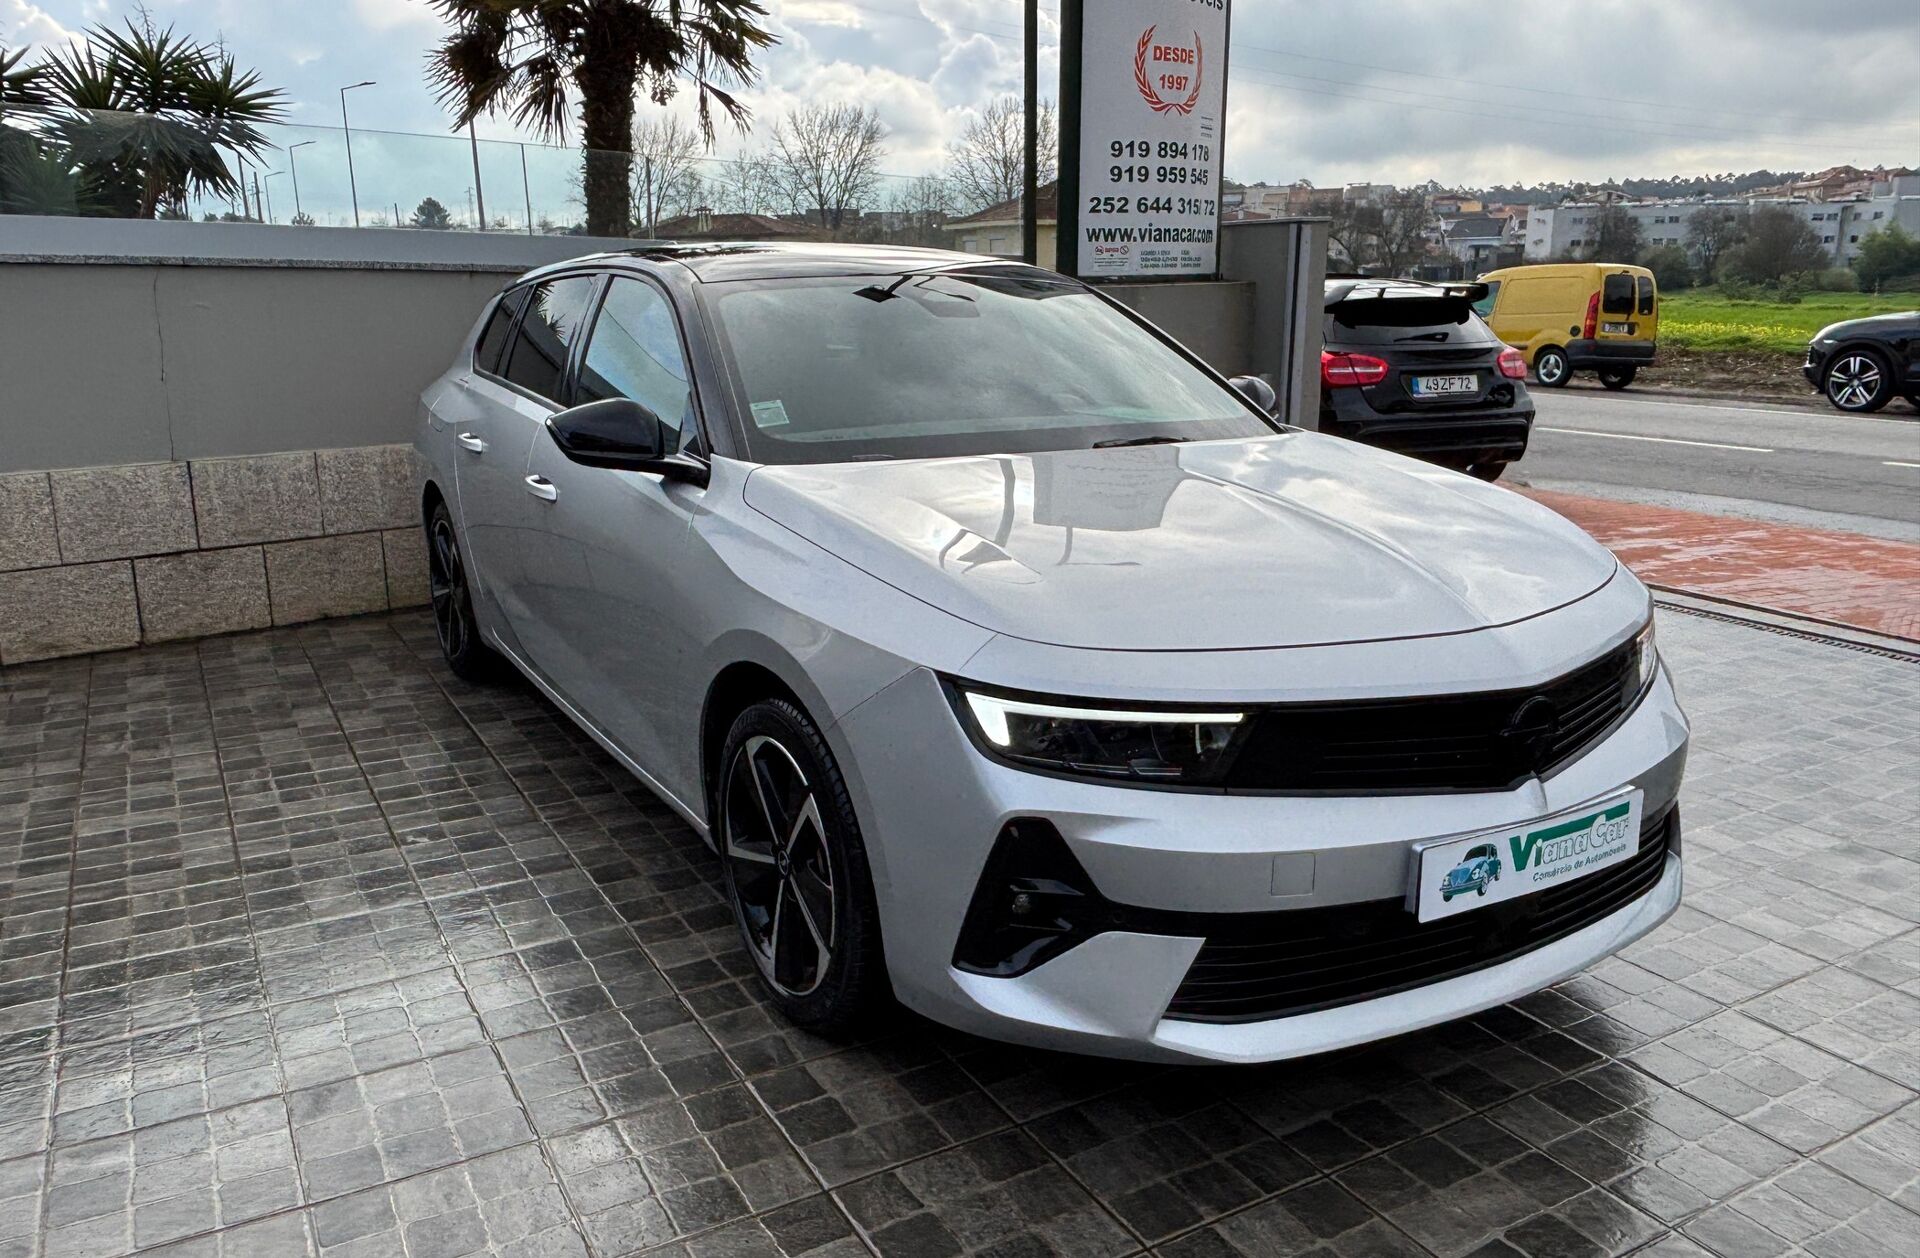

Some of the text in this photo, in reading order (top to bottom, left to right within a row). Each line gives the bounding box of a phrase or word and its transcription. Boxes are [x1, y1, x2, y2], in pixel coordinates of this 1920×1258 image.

[1153, 45, 1195, 65] DESDE
[1159, 74, 1189, 92] 1997
[1110, 140, 1209, 162] 919 894 178
[1109, 165, 1208, 186] 919 959 545
[1088, 196, 1129, 214] 252
[1136, 196, 1173, 214] 644
[1085, 222, 1214, 244] www.vianacar.com
[1509, 803, 1630, 872] VianaCar
[1574, 860, 1586, 870] de
